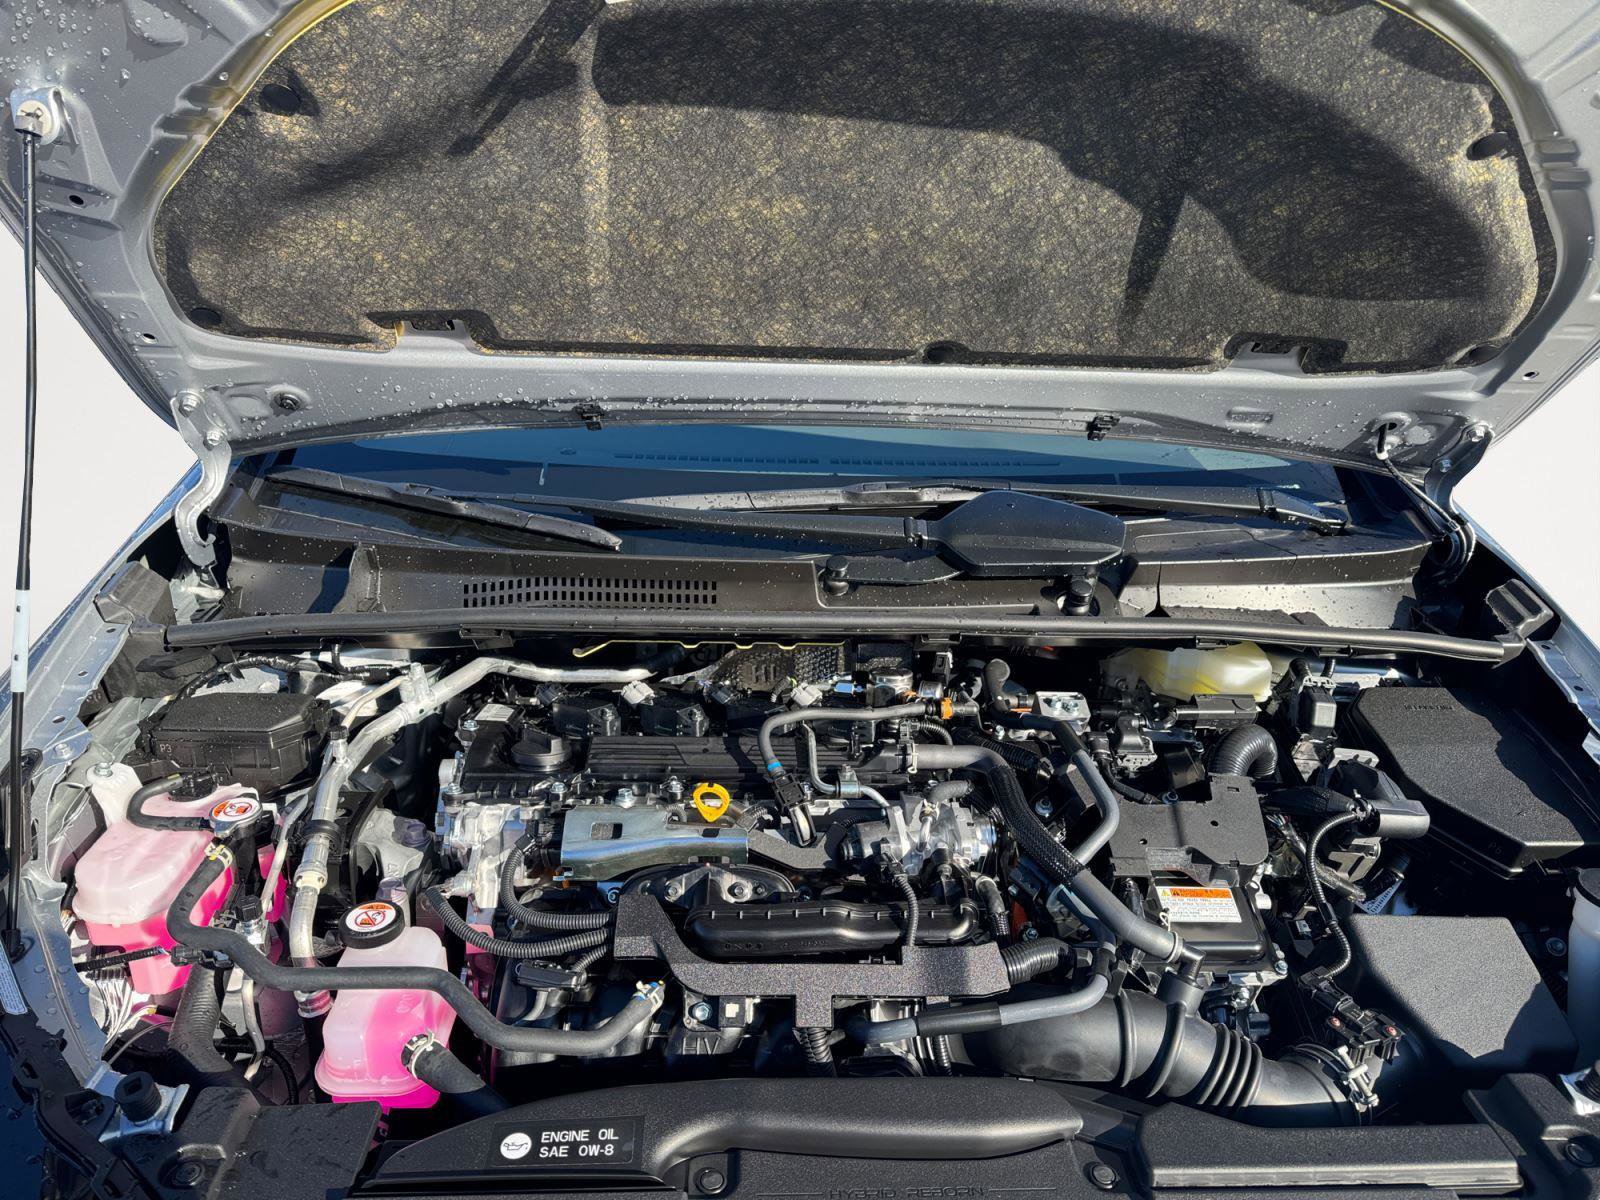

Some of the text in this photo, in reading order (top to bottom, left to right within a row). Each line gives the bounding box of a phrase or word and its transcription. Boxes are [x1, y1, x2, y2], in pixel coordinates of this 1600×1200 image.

[540, 1128, 619, 1143] ENGINE OIL
[539, 1143, 615, 1158] SAE 0W-8
[829, 1186, 984, 1200] HYBRID REBORN
